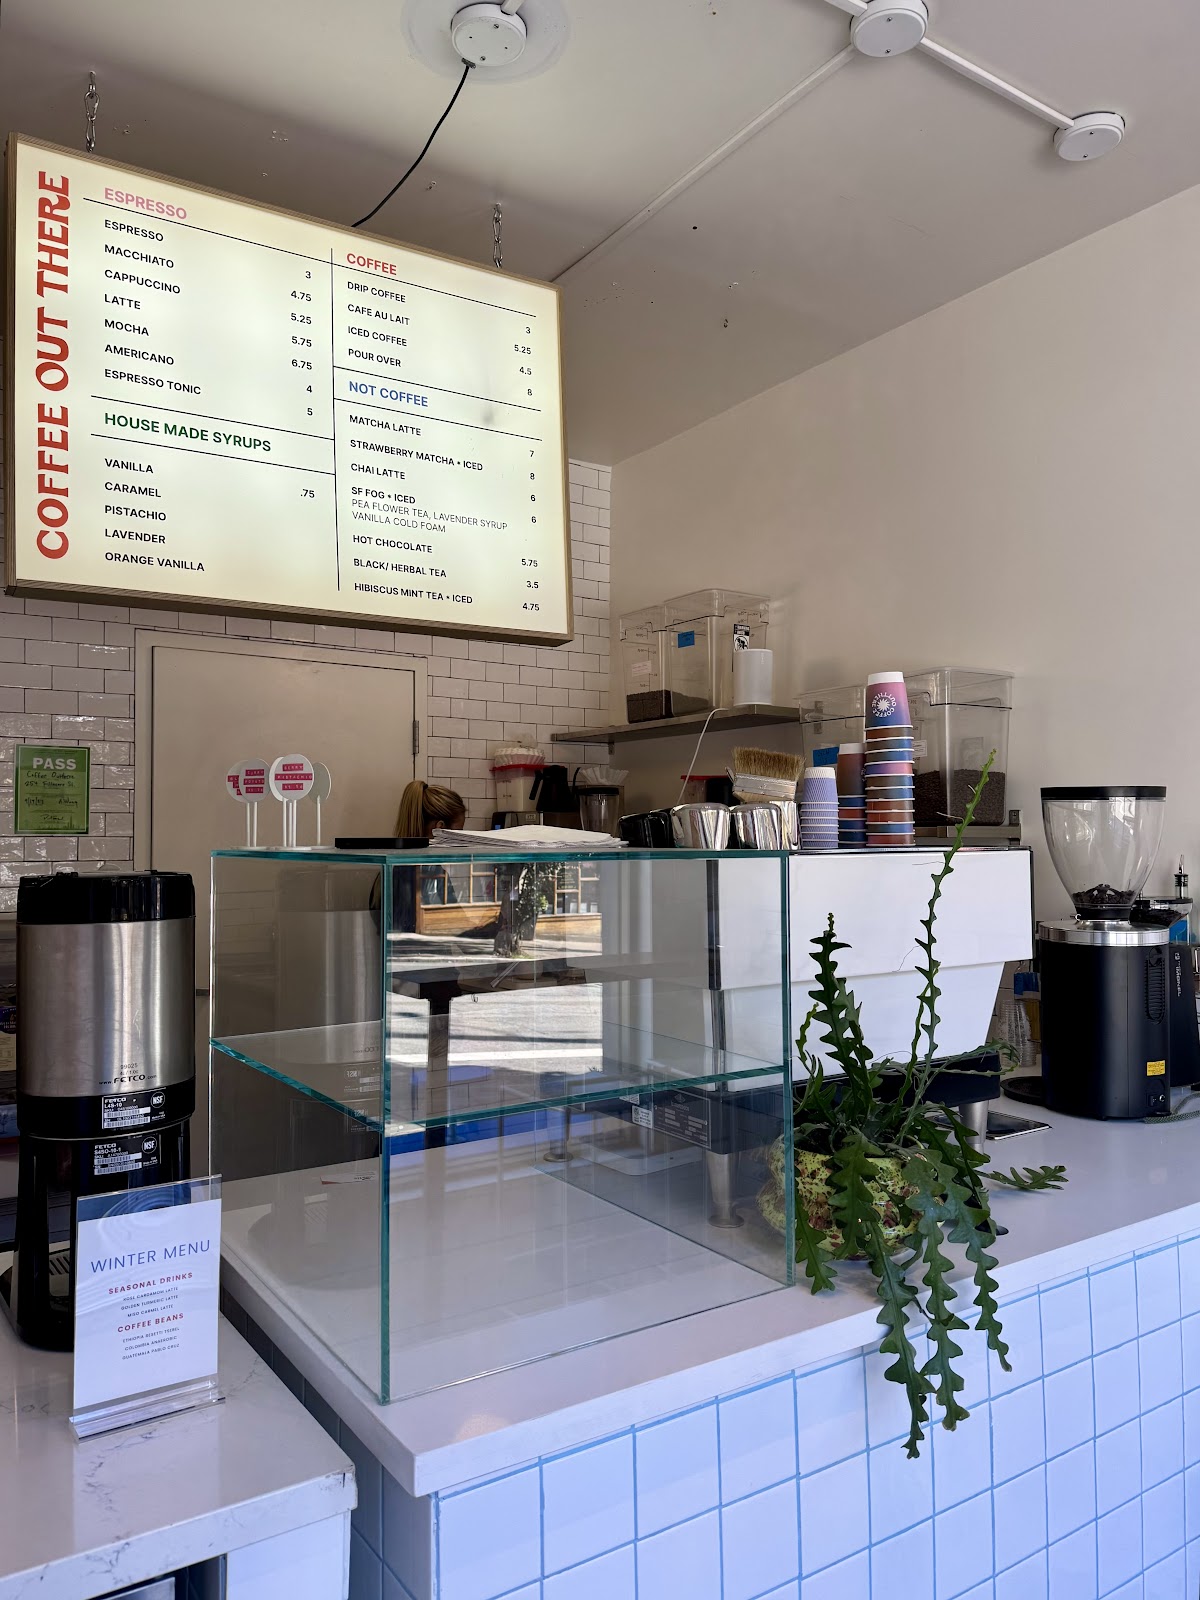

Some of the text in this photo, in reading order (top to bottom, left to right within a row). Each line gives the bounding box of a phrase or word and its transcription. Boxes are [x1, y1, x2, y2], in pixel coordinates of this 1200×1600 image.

[104, 187, 187, 220] ESPRESSO
[104, 219, 164, 242] ESPRESSO
[104, 244, 174, 269] MACCHIATO
[346, 253, 397, 276] COFFEE
[104, 269, 181, 294] CAPPUCCINO
[305, 270, 311, 279] 3
[291, 290, 312, 302] 4.75
[347, 282, 406, 303] DRIP COFFEE
[104, 293, 141, 310] LATTE
[291, 313, 312, 325] 5.25
[347, 303, 410, 326] CAFE AU LAIT
[104, 318, 149, 336] MOCHA
[526, 326, 531, 335] 3
[291, 336, 312, 348] 5.75
[347, 326, 408, 347] ICED COFFEE
[104, 344, 174, 366] AMERICANO
[348, 348, 402, 367] POUR OVER
[514, 344, 532, 355] 5.25
[35, 171, 71, 559] COFFEE OUT THERE
[291, 359, 312, 370] 6.75
[519, 366, 532, 376] 4.5
[104, 368, 202, 395] ESPRESSO TONIC
[306, 384, 312, 394] 4
[349, 381, 429, 408] NOT COFFEE
[307, 407, 313, 416] 5
[104, 412, 271, 452] HOUSE MADE SYRUPS
[349, 414, 422, 436] MATCHA LATTE
[350, 439, 483, 471] STRAWBERRY MATCHA ICED
[529, 450, 535, 458] 7
[104, 458, 154, 474] VANILLA
[350, 463, 406, 480] CHAI LATTE
[530, 472, 535, 481] 8
[104, 481, 161, 498] CARAMEL
[300, 489, 315, 499] .75
[351, 486, 416, 505] SF FOG ICED
[531, 494, 536, 502] 6
[104, 505, 167, 521] PISTACHIO
[352, 499, 508, 530] PEA FLOWER TEA, LAVENDER SYRUP
[531, 516, 537, 524] 6
[352, 510, 446, 533] VANILLA COLD FOAM
[104, 528, 166, 544] LAVENDER
[352, 535, 433, 554] HOT CHOCOLATE
[104, 552, 205, 572] ORANGE VANILLA
[353, 559, 447, 578] BLACK/ HERBAL TEA
[521, 559, 538, 567] 5.75
[526, 581, 539, 589] 3.5
[354, 583, 473, 604] HIBISCUS MINT TEA ICED
[522, 603, 540, 611] 4.75
[32, 757, 77, 770] PASS
[152, 1095, 164, 1105] NSF
[94, 1142, 117, 1150] FETCO
[143, 1140, 155, 1151] NSF
[90, 1239, 211, 1273] WINTER MENU
[108, 1272, 193, 1295] SEASONAL DRINKS
[120, 1303, 140, 1311] GOLDEN
[141, 1297, 165, 1307] TURMERIC
[160, 1303, 174, 1311] LATTE
[117, 1312, 185, 1333] COFFEE BEANS
[122, 1334, 144, 1343] ETHIOPIA
[124, 1335, 178, 1351] COLOMBIA ANAEROBIC
[121, 1350, 150, 1361] GUATEMALA
